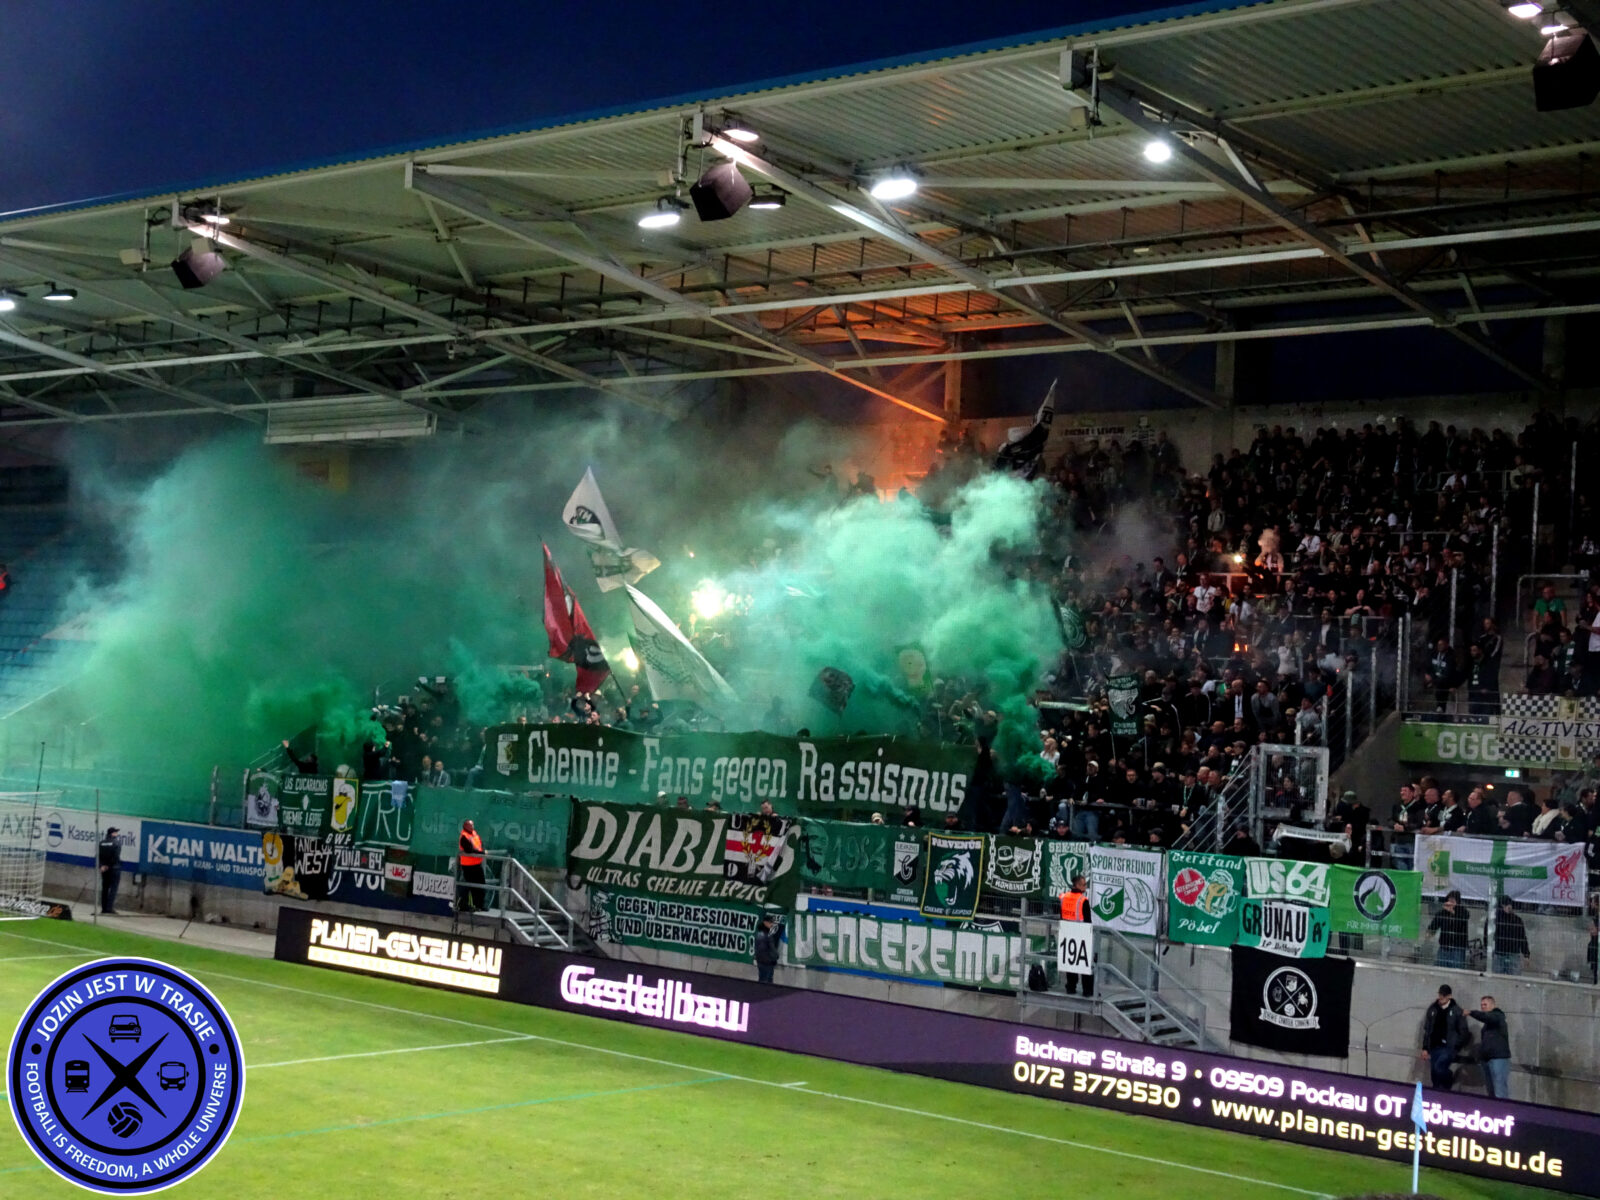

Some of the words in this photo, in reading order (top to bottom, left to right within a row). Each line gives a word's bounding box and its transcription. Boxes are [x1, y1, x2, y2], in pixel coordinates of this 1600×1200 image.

[528, 730, 619, 788] Chemie
[640, 737, 706, 795] Fans
[711, 757, 787, 802] gegen
[797, 742, 967, 812] Rassismus
[147, 834, 204, 863] KRAN
[571, 806, 801, 881] DIABLS
[215, 863, 231, 873] UND
[294, 851, 332, 875] WEST
[1091, 854, 1156, 877] SPORTSFREUNDE
[1093, 875, 1123, 885] LEIPZIG
[1250, 861, 1327, 900] US64
[586, 865, 642, 889] ULTRAS
[646, 875, 707, 897] CHEMIE
[708, 880, 768, 903] LEIPZIG
[1551, 889, 1576, 900] LFC
[616, 896, 657, 916] GEGEN
[659, 902, 758, 933] REPRESSIONEN
[1242, 900, 1307, 943] GRÜNAU
[309, 918, 503, 976] PLANEN-GESTELLBAU
[615, 917, 643, 937] UND
[645, 916, 748, 953] ÜBERWACHUNG
[1060, 937, 1089, 967] 19A
[560, 964, 750, 1033] Gestellbau
[1015, 1035, 1097, 1067] Buchener
[1101, 1050, 1166, 1079] Straße
[1171, 1060, 1187, 1081] 9
[1209, 1066, 1285, 1098] 09509
[1290, 1080, 1368, 1113] Pockau
[1374, 1093, 1407, 1119] OT
[1013, 1061, 1065, 1089] 0172
[1072, 1071, 1181, 1109] 3779530
[1211, 1099, 1563, 1178] www.planen-gestellbau.de
